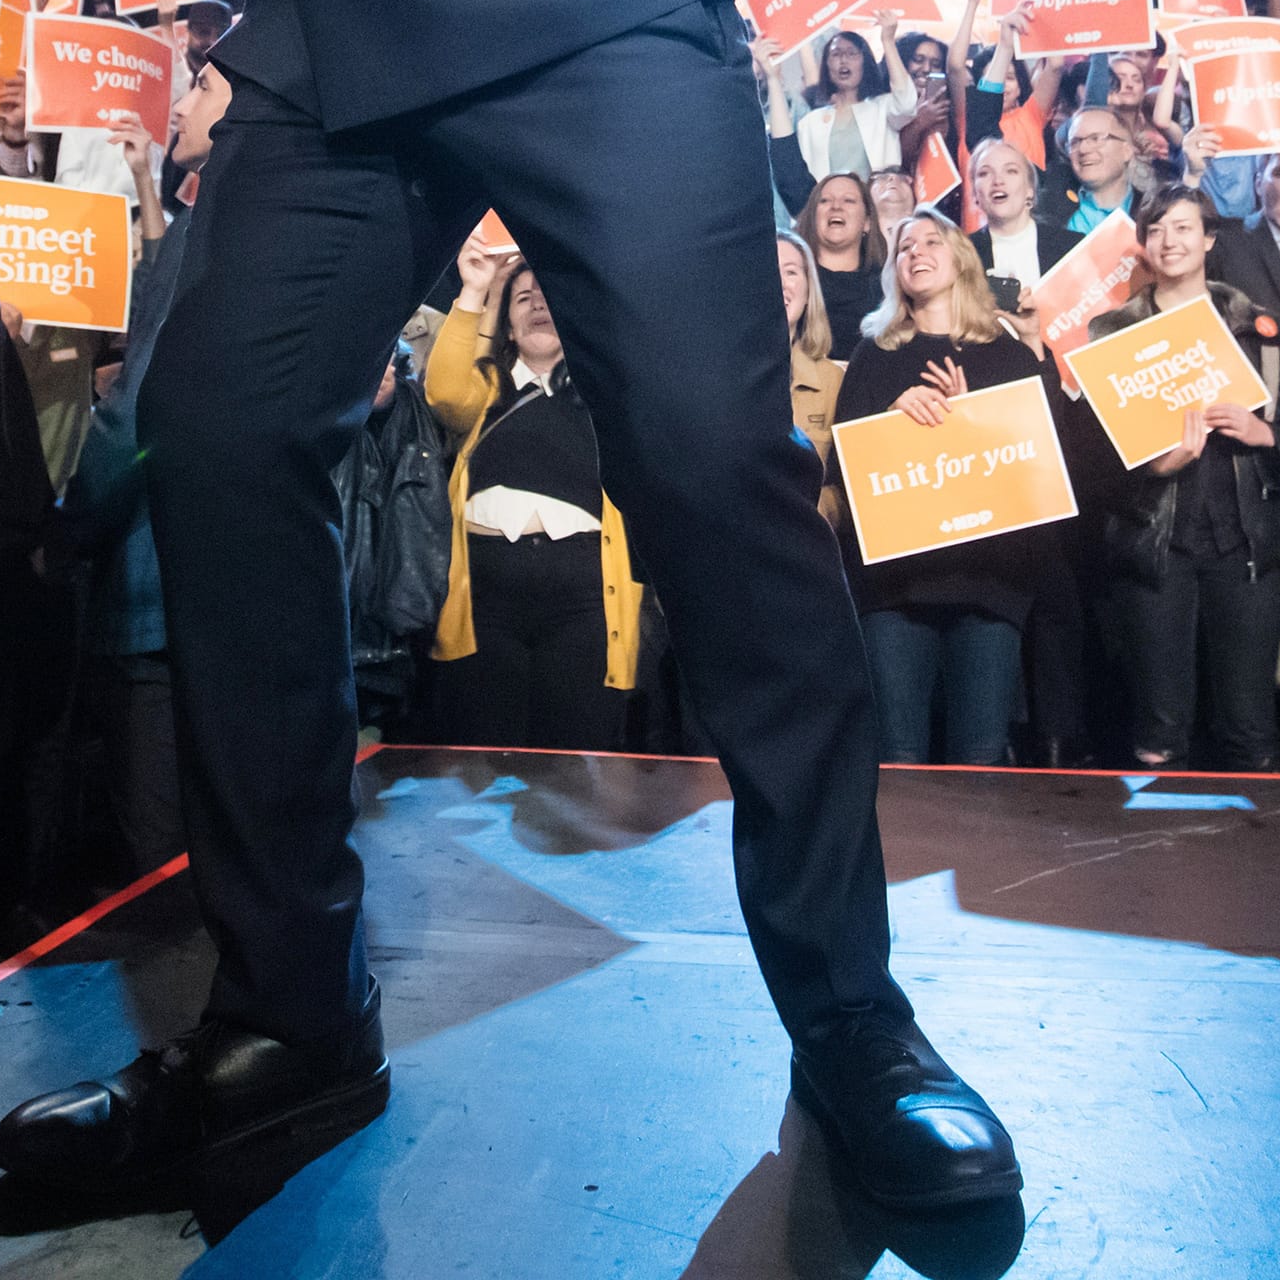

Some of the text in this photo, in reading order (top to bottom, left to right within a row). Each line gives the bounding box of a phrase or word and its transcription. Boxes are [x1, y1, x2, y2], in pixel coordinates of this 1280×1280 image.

[53, 41, 93, 64] We
[97, 46, 164, 81] choose
[92, 70, 142, 92] you!
[4, 204, 49, 221] NDP
[1046, 255, 1139, 341] #UpriSingh
[1107, 339, 1216, 408] Jagmeet
[1160, 366, 1231, 411] Singh
[868, 439, 1037, 496] In it for you
[951, 509, 994, 531] NDP
